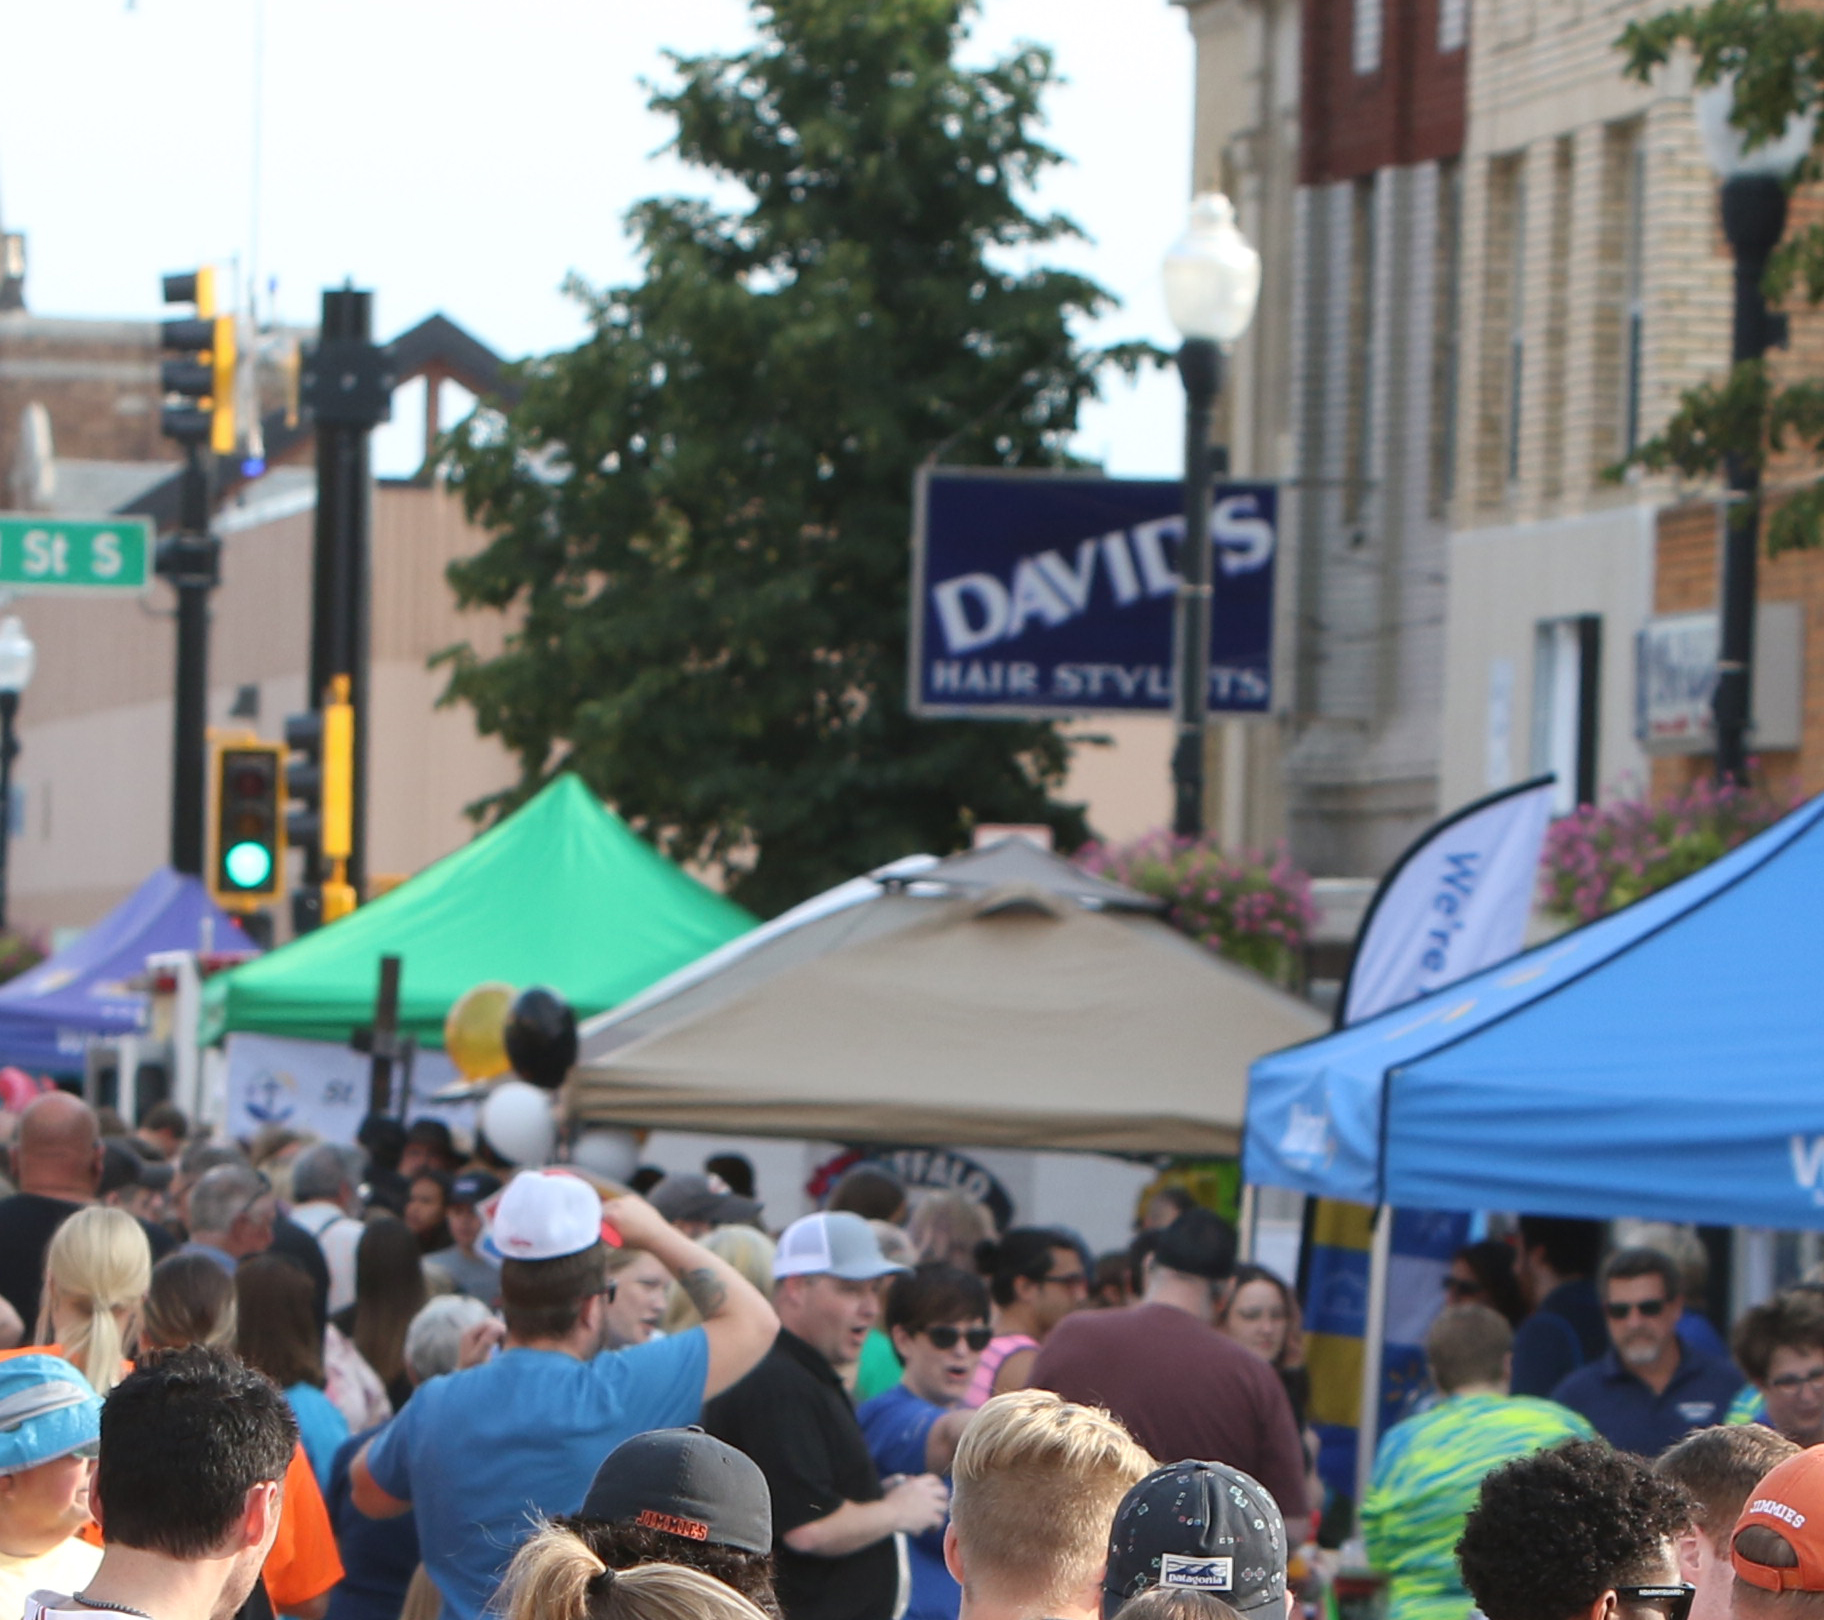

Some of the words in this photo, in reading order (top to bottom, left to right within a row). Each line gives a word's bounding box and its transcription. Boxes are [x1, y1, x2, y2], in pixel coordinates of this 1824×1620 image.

[22, 529, 69, 576] St
[91, 532, 123, 578] S
[932, 659, 1040, 694] HAIR
[1052, 662, 1267, 699] STYLTS
[1422, 852, 1481, 973] We're
[635, 1509, 709, 1542] JIMMIES
[1749, 1499, 1807, 1530] JIMMIES
[1168, 1573, 1224, 1585] patagonia
